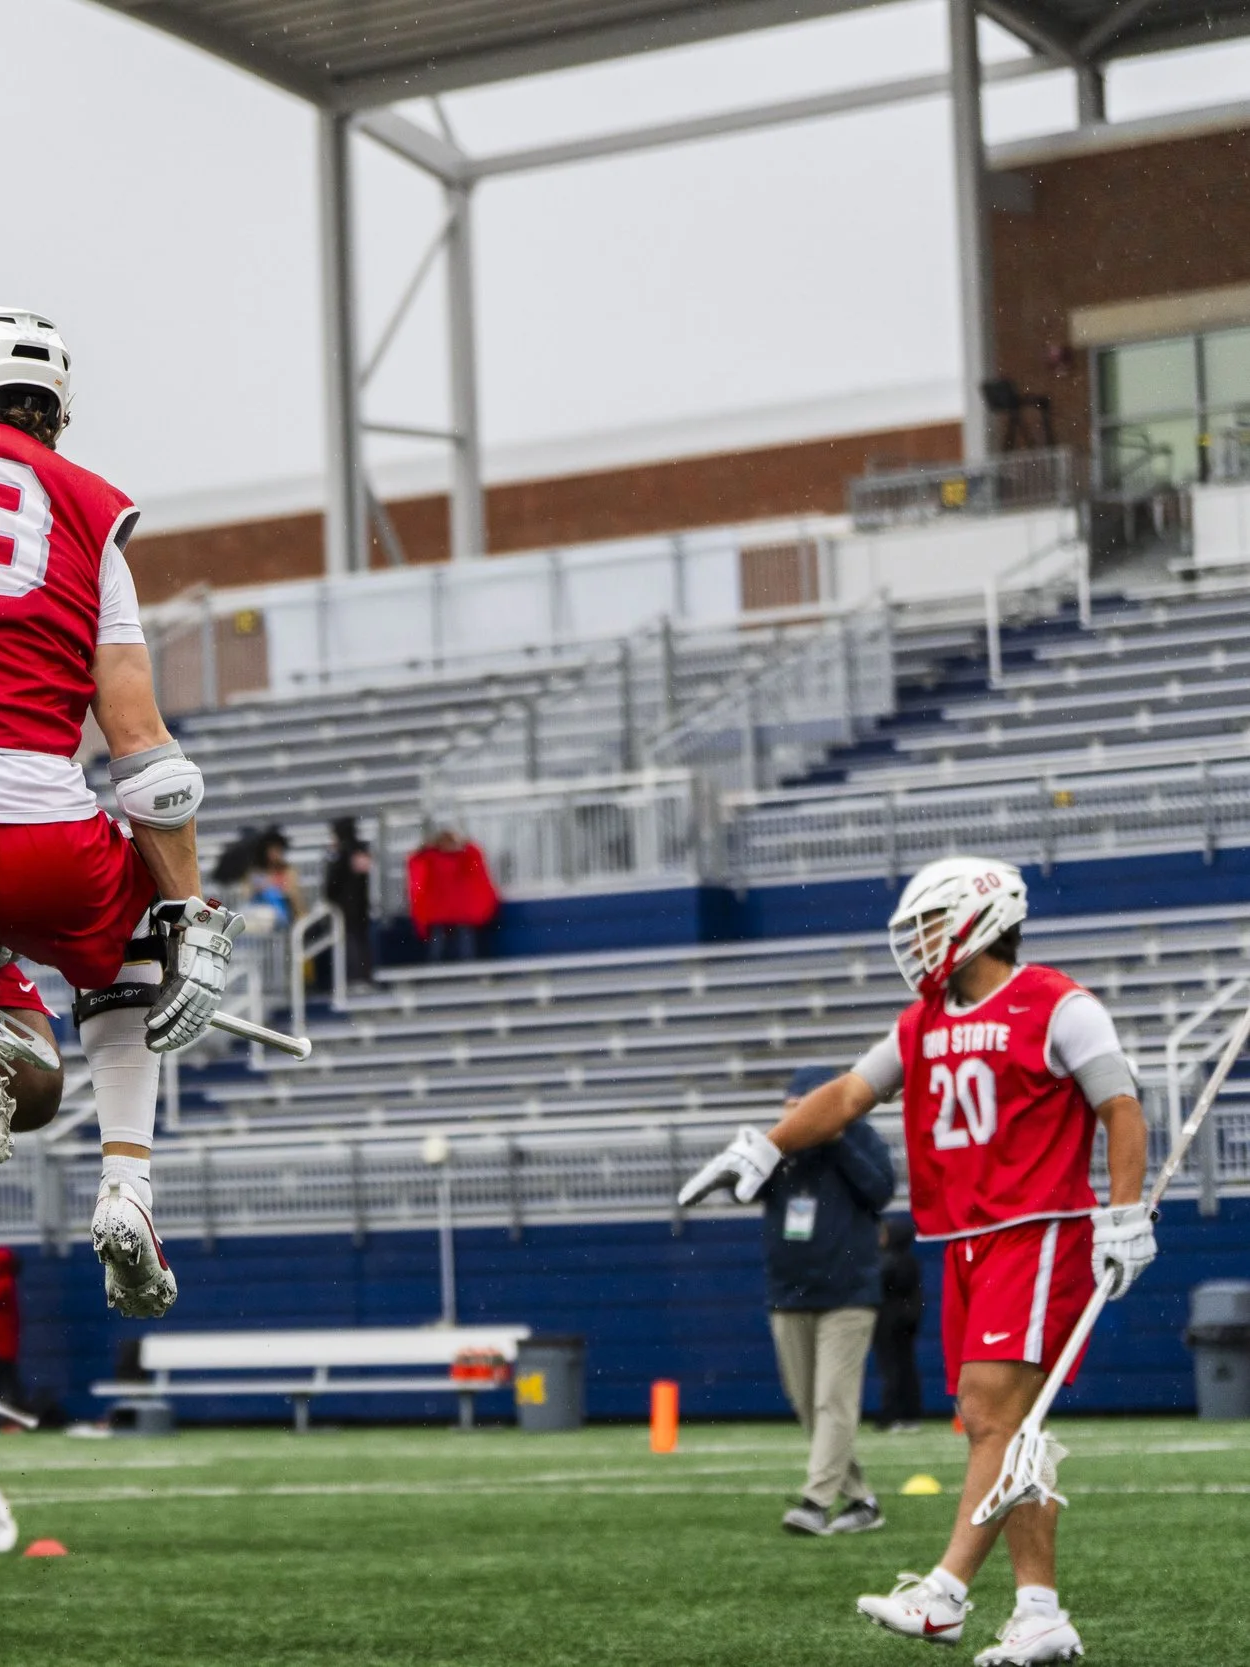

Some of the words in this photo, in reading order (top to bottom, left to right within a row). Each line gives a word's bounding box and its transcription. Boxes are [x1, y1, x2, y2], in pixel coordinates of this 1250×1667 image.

[153, 784, 193, 810] STX
[972, 872, 1002, 896] 20
[90, 989, 142, 1006] DONJOY
[951, 1021, 1011, 1054] STATE
[929, 1058, 998, 1150] 20
